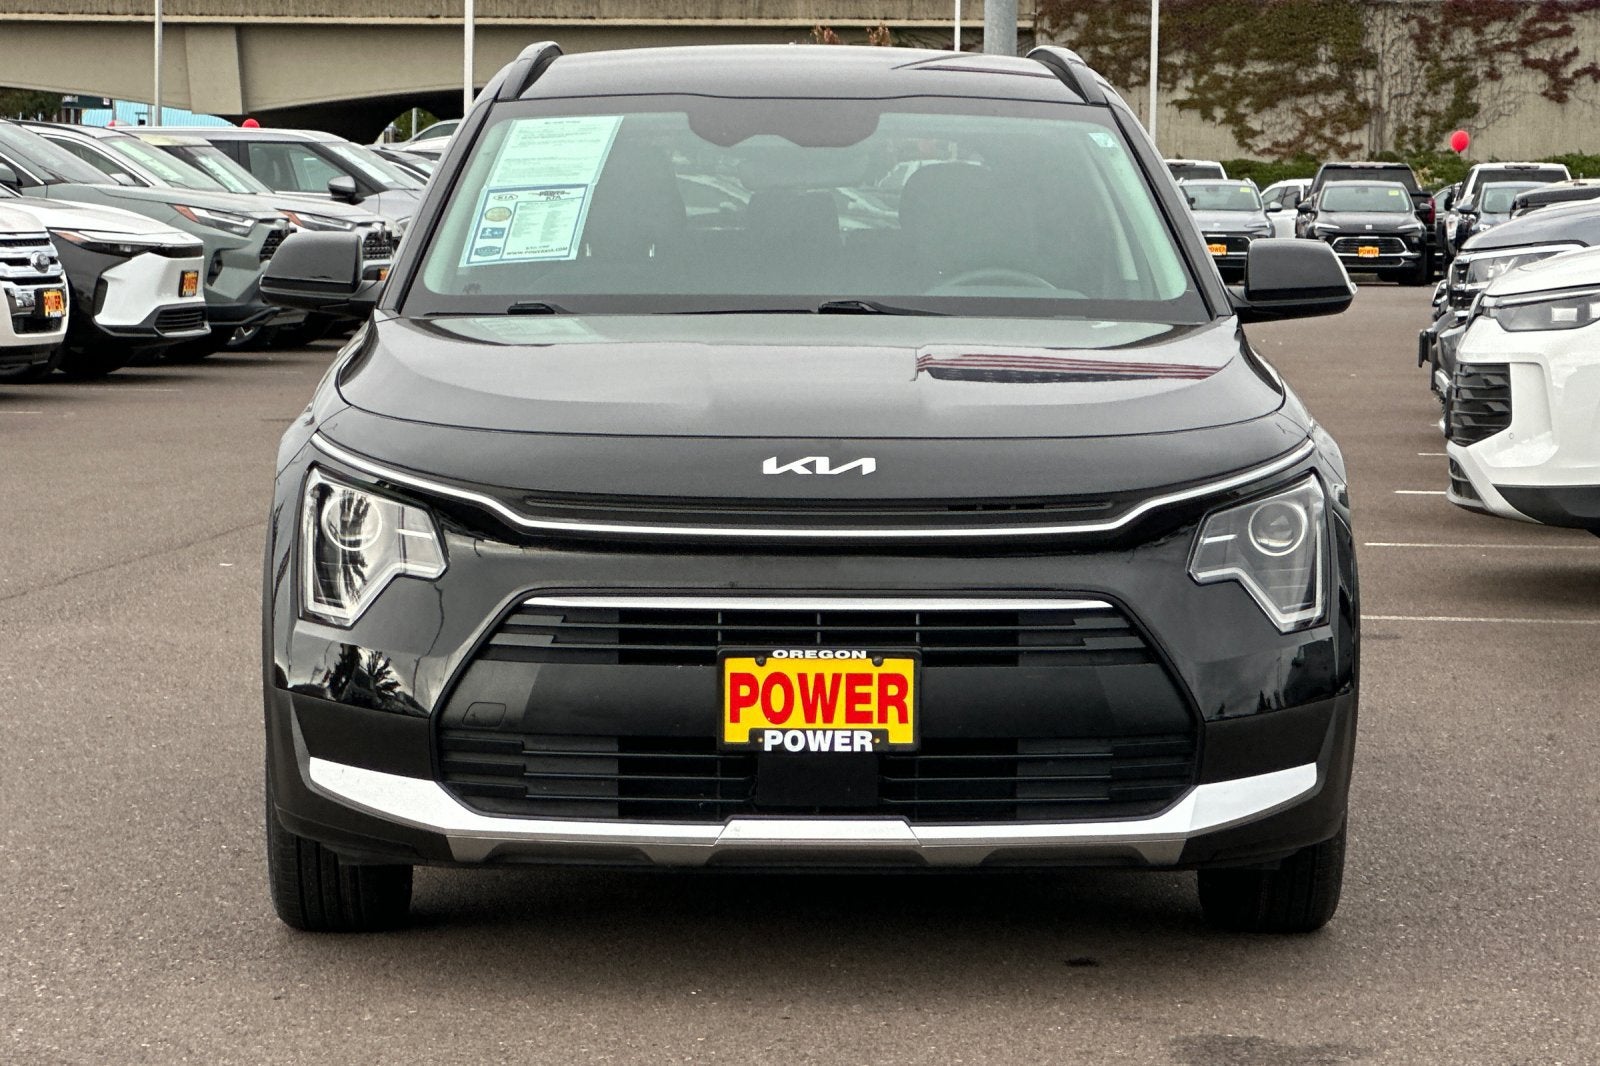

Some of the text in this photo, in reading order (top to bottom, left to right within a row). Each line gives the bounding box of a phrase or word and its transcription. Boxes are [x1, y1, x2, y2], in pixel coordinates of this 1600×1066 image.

[763, 456, 876, 475] KIA
[772, 650, 867, 659] OREGON
[729, 672, 909, 724] POWER
[763, 730, 873, 752] POWER
